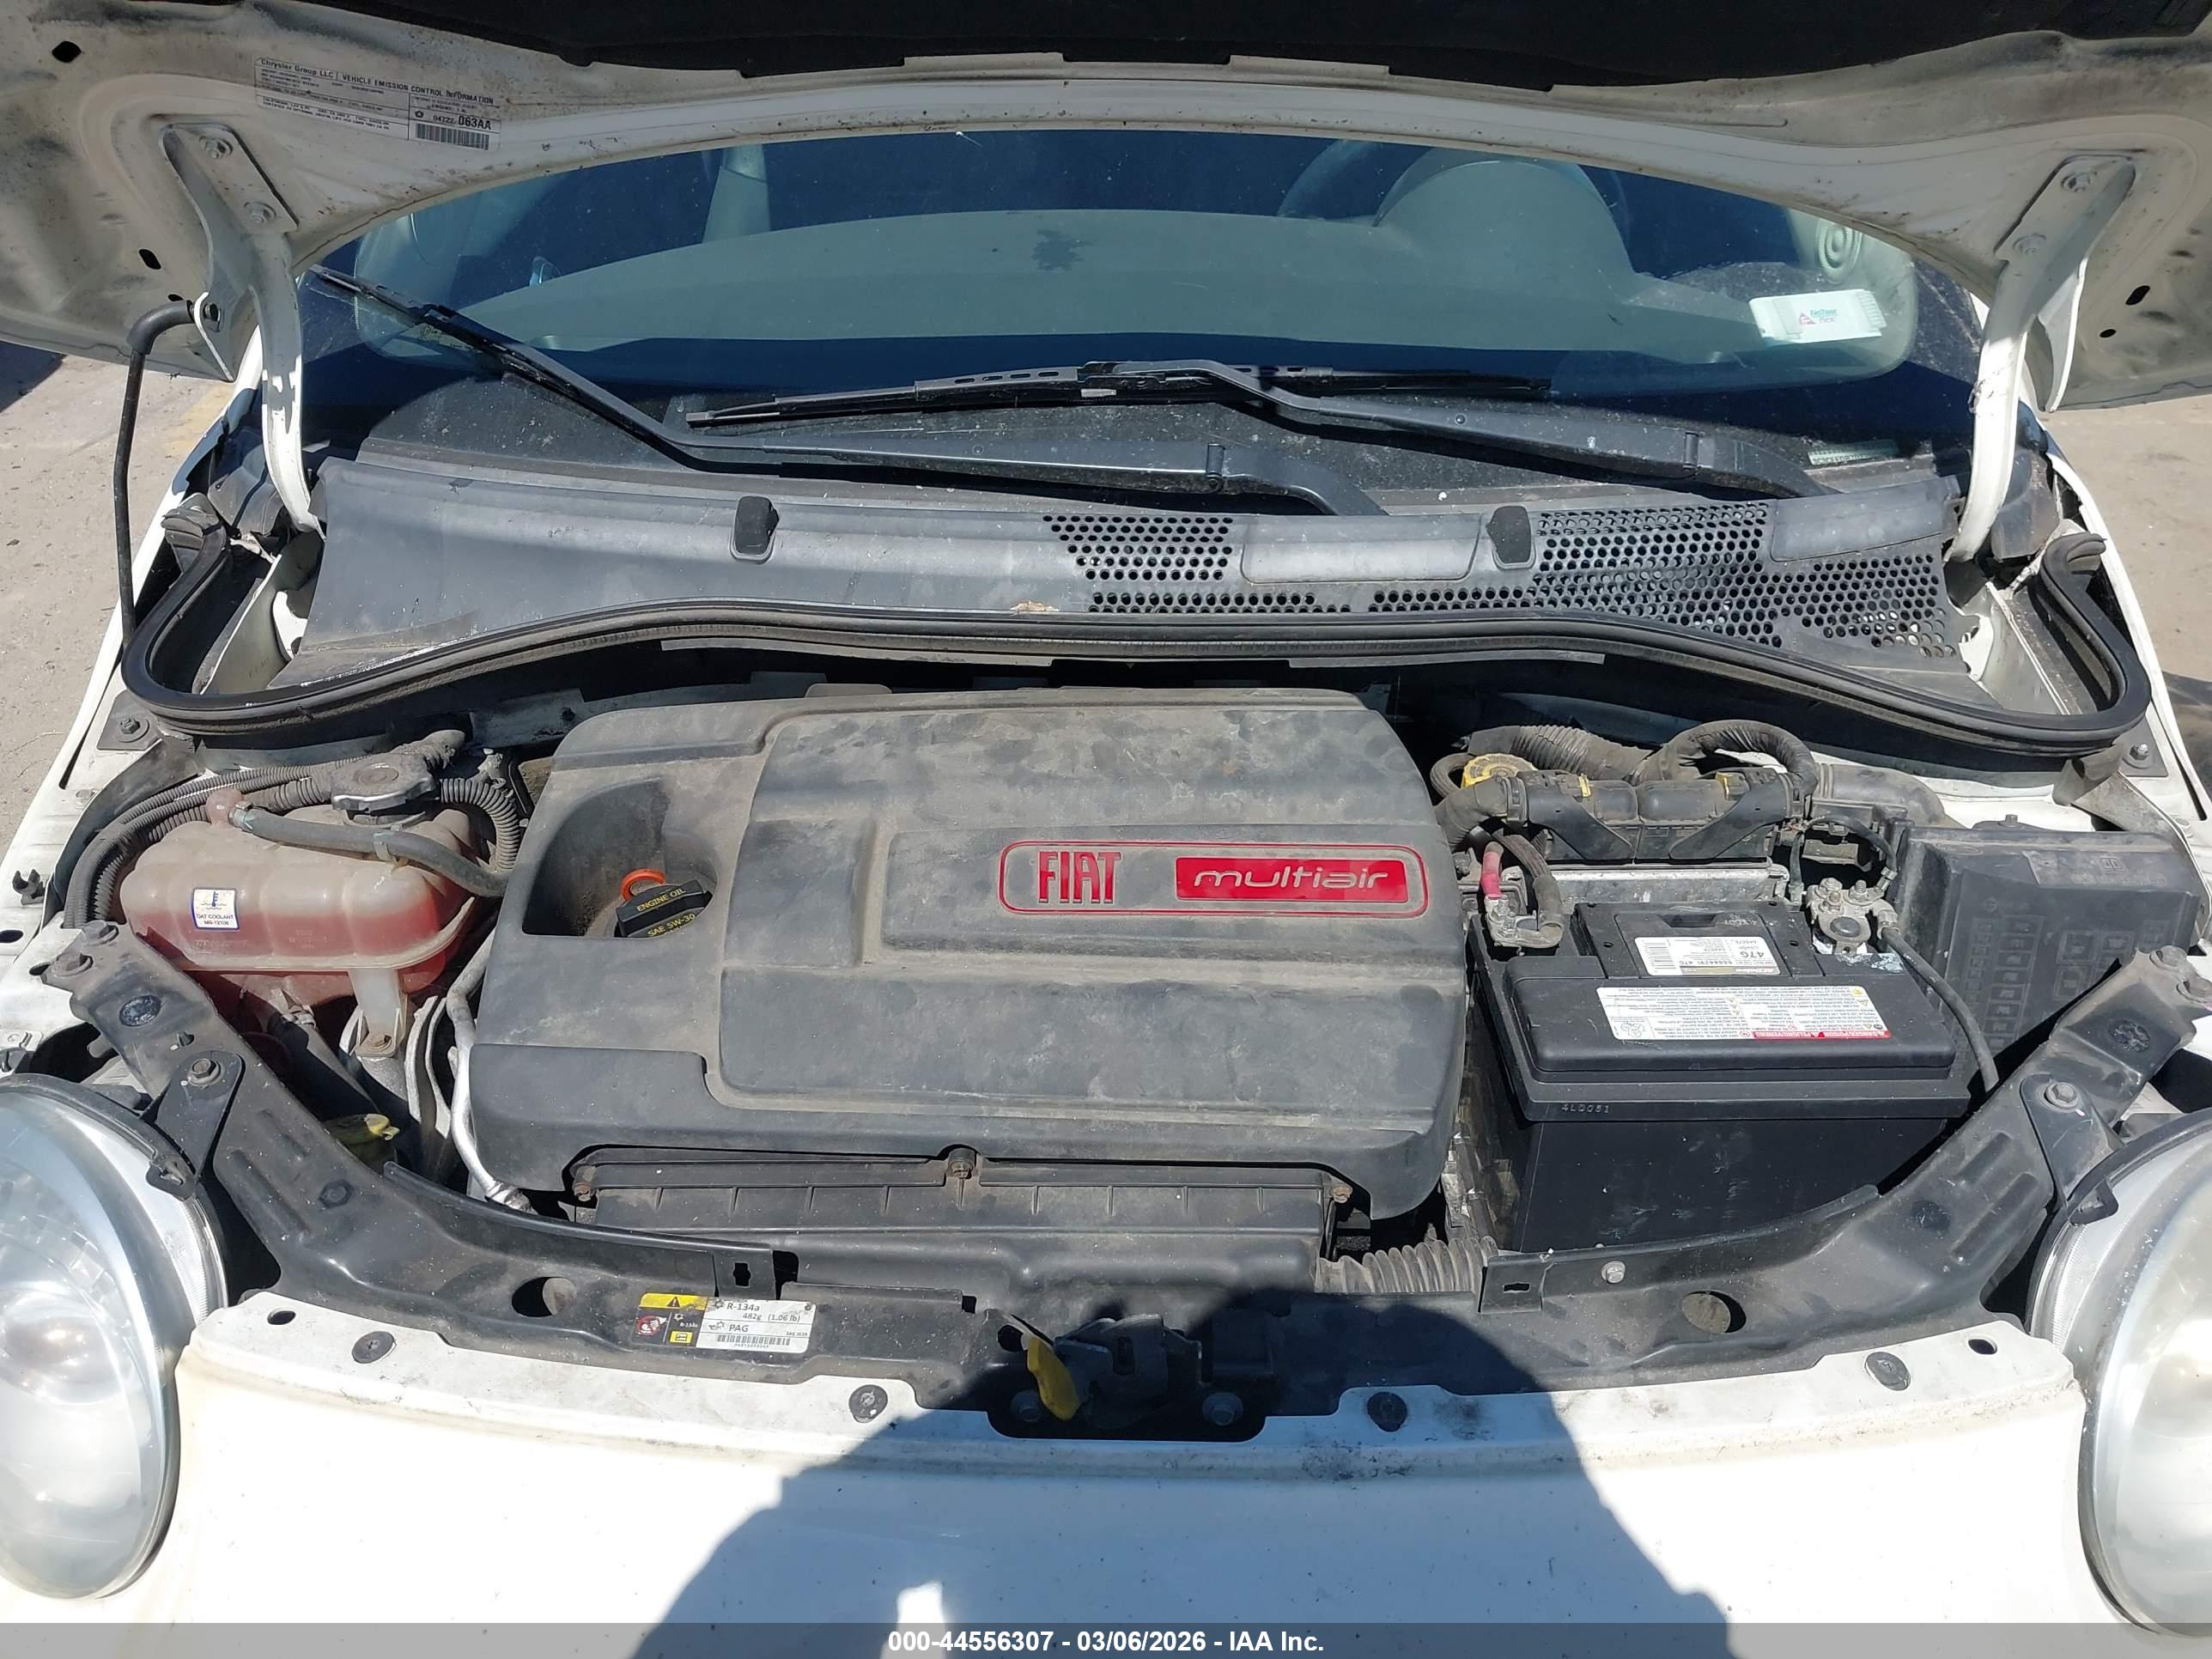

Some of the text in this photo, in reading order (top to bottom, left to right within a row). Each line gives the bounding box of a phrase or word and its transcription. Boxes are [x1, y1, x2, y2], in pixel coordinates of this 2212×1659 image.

[261, 59, 292, 70] Chrysler
[295, 65, 317, 76] Group
[342, 74, 372, 85] VEHICLE
[374, 79, 409, 91] EMISSION
[410, 85, 443, 96] CONTROL
[446, 89, 494, 105] INFORMATION
[458, 115, 491, 131] 063AA
[1037, 850, 1121, 903] FIAT
[1194, 866, 1389, 890] multiair
[637, 888, 686, 912] ENGINE OIL
[647, 926, 665, 937] SAE
[666, 913, 696, 929] 5W-30
[726, 1302, 760, 1311] R-134a
[742, 1312, 763, 1321] 482g
[768, 1313, 788, 1322] (1.06
[729, 1324, 749, 1333] PAG
